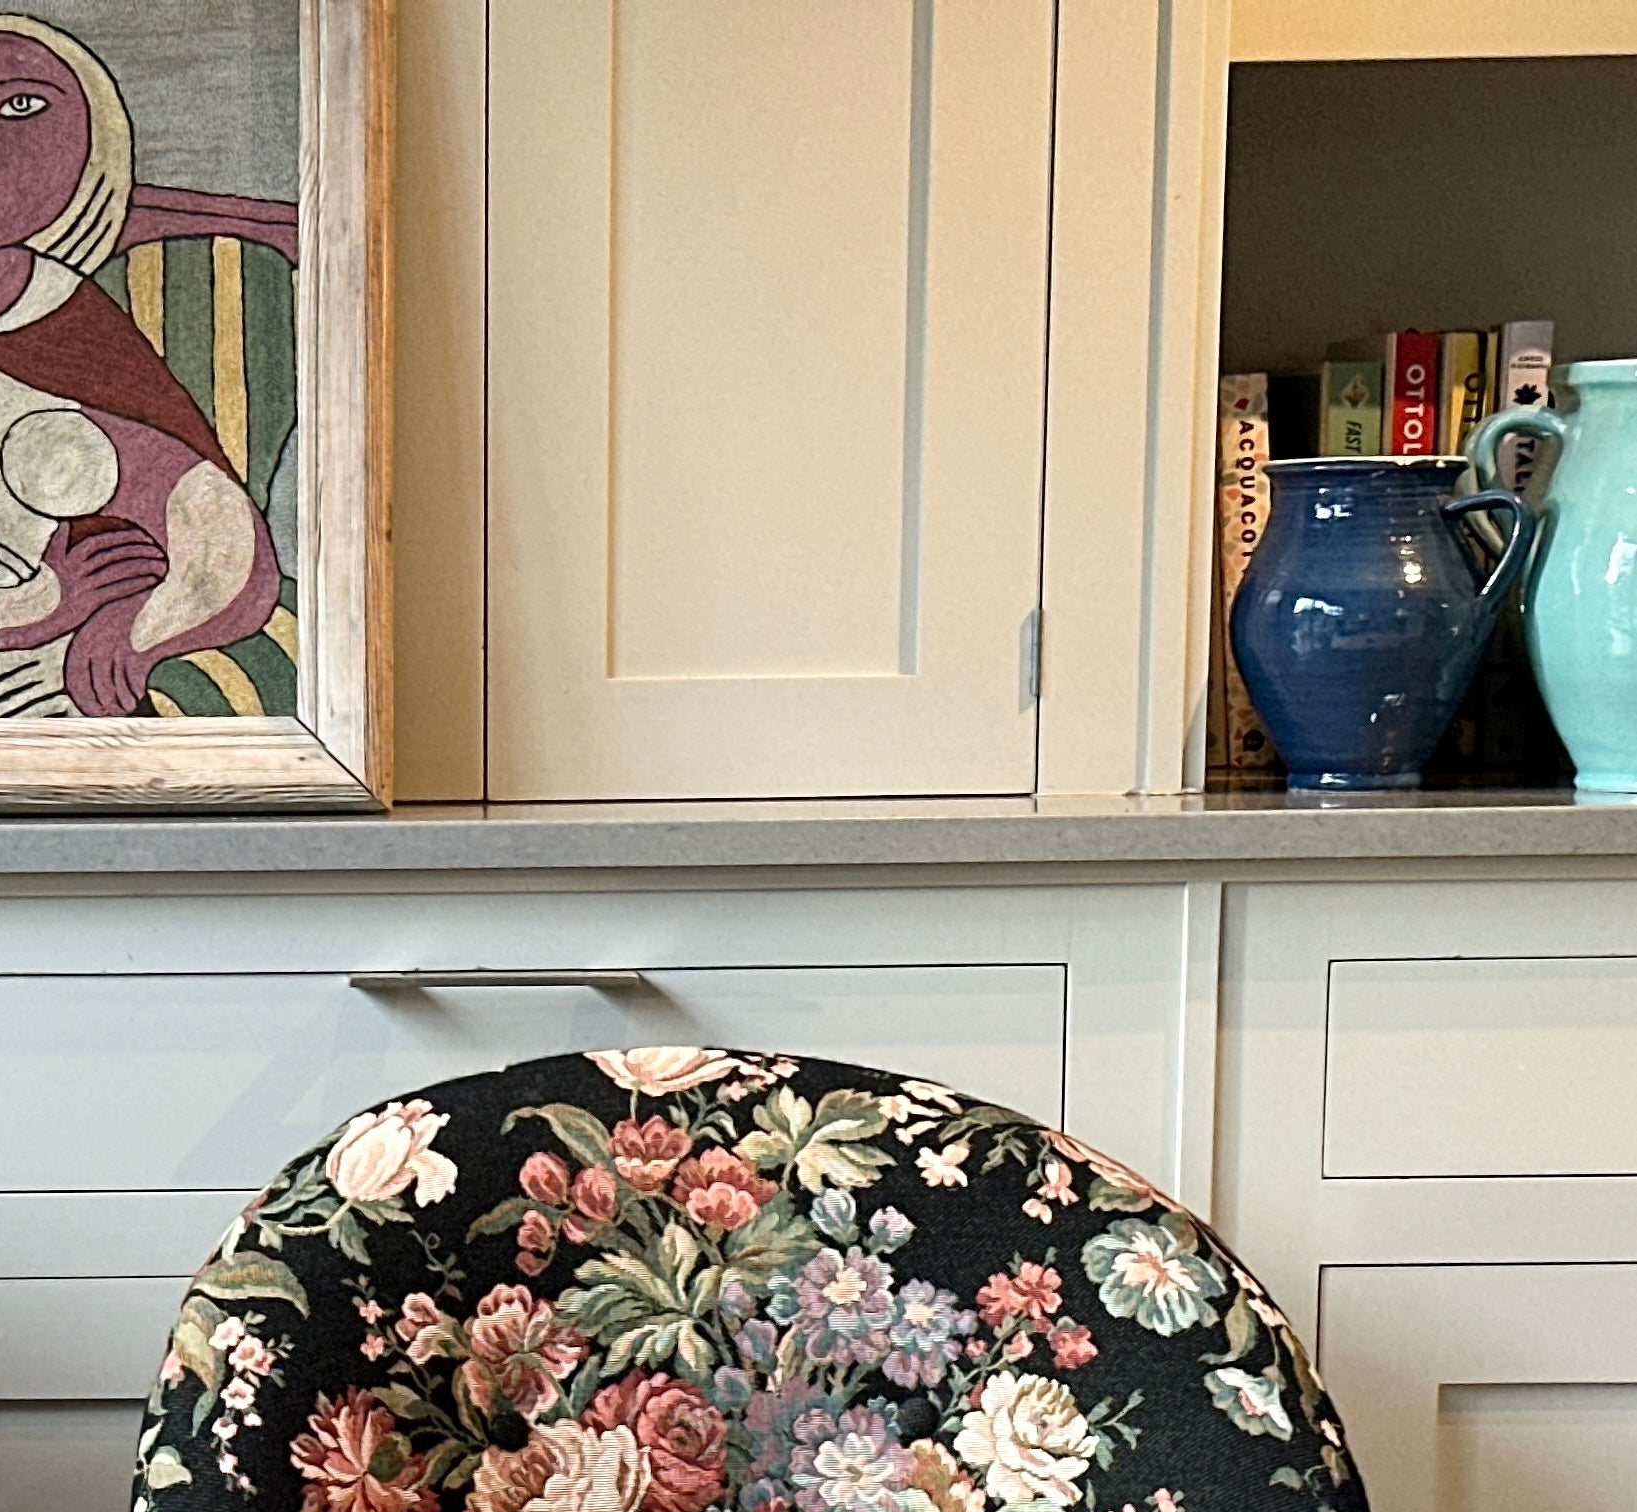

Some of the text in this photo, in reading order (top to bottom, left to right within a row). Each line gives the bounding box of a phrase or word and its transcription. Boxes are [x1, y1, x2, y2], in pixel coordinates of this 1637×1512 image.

[1345, 420, 1362, 453] FAST
[1403, 364, 1426, 454] OTTOL
[1235, 420, 1257, 559] ACQUACOT
